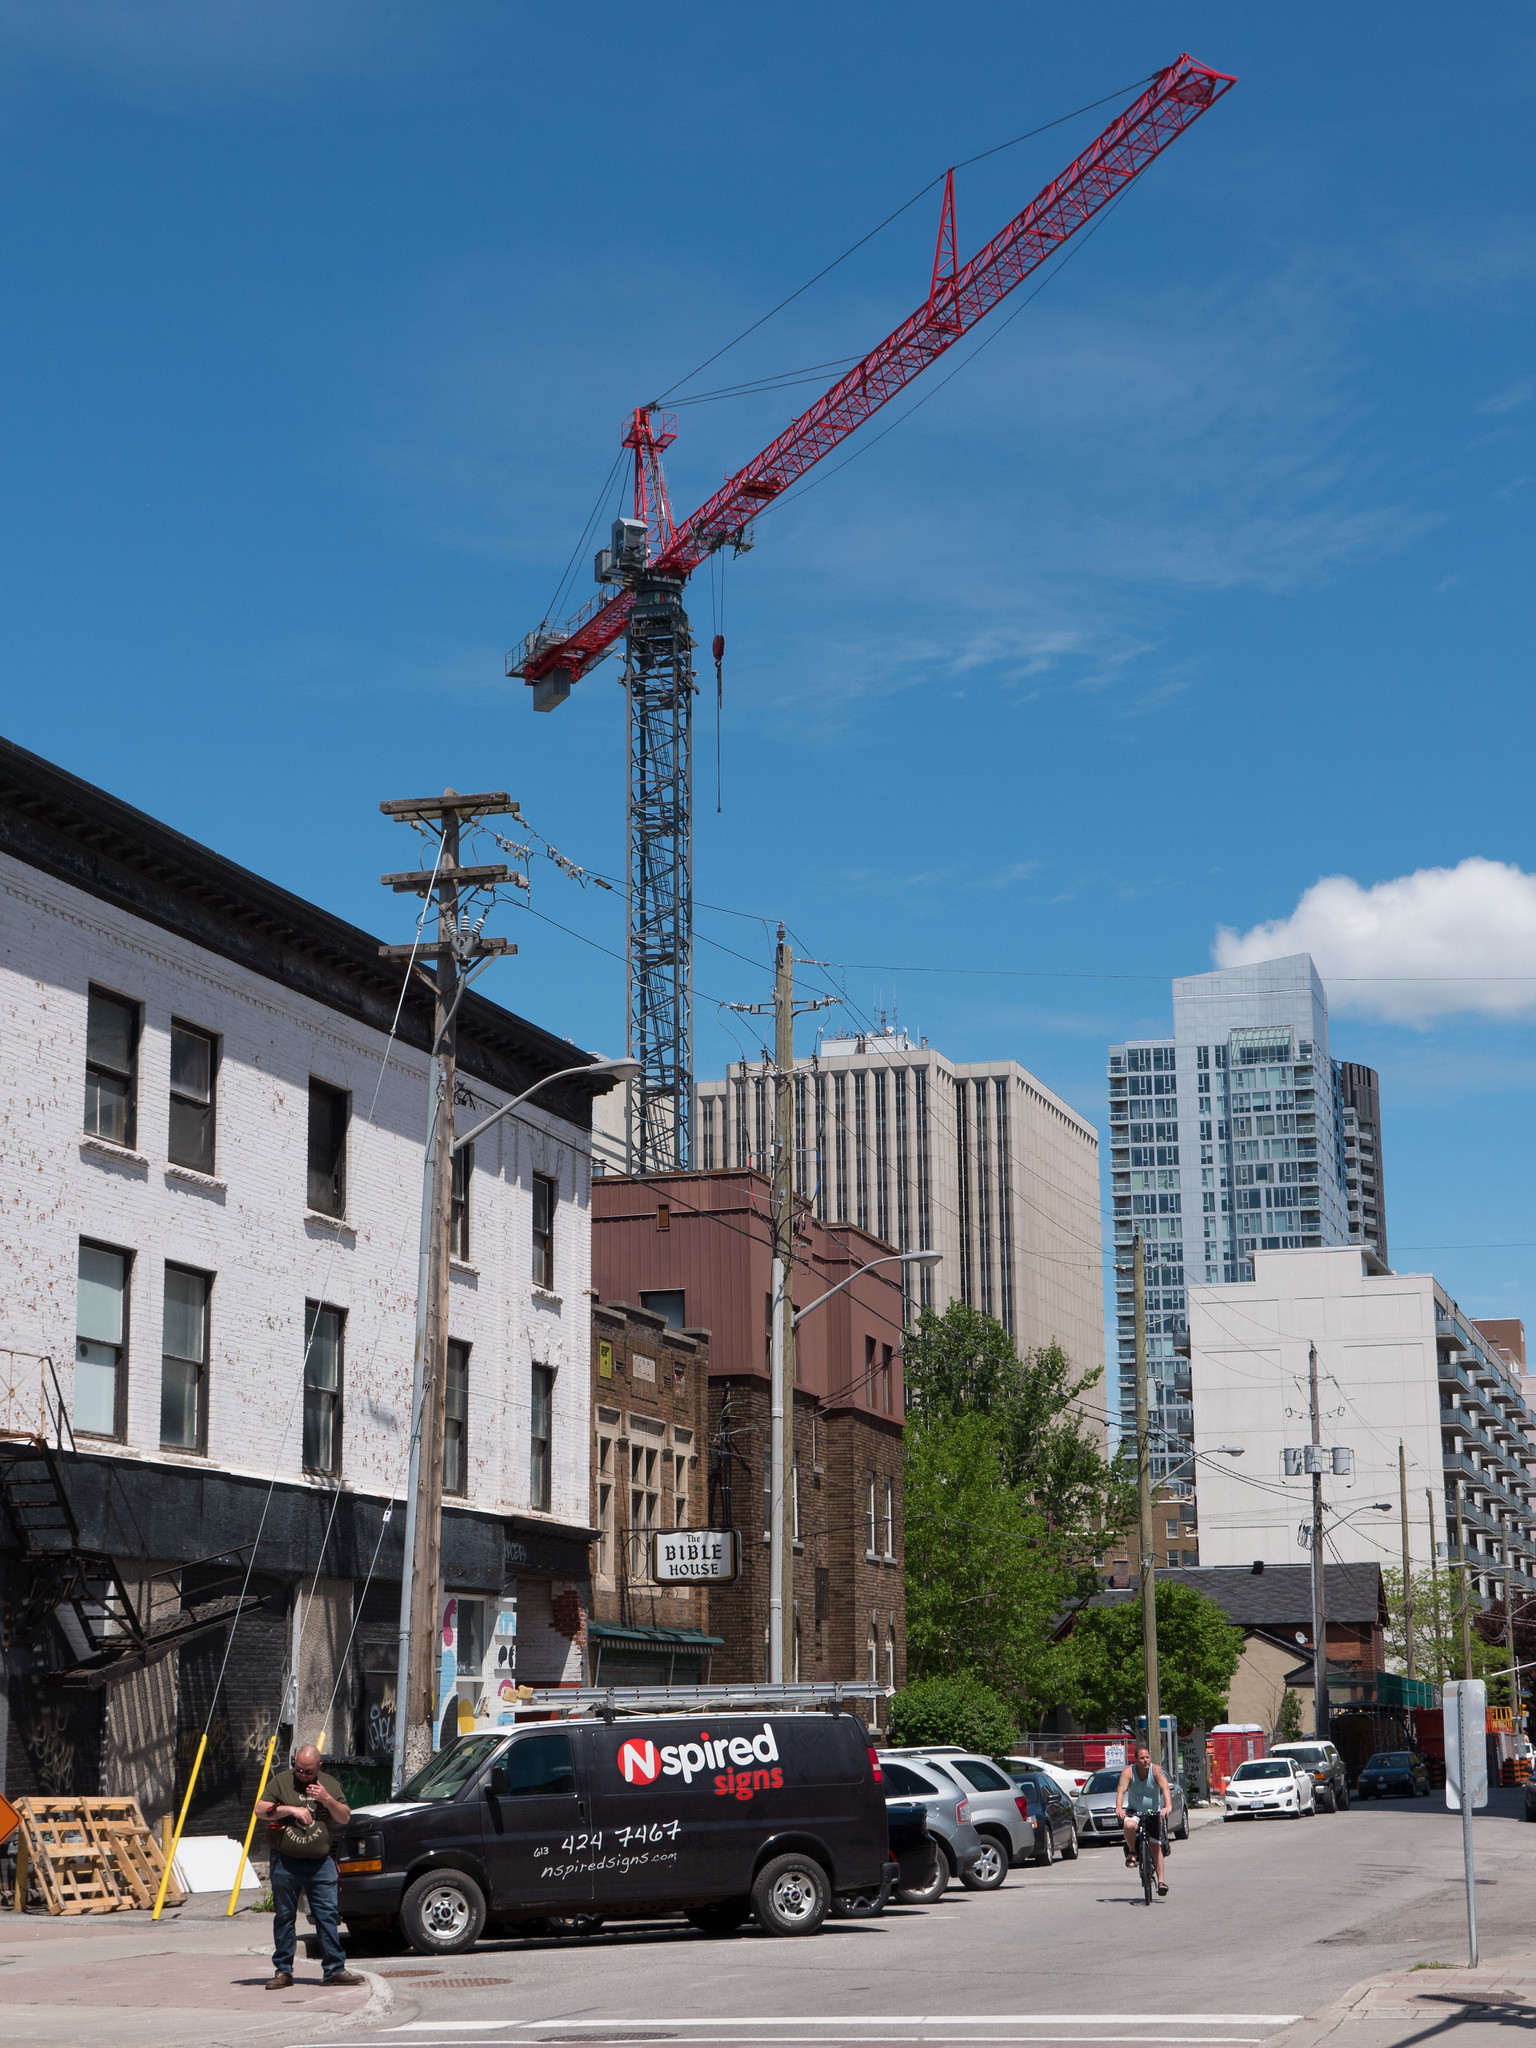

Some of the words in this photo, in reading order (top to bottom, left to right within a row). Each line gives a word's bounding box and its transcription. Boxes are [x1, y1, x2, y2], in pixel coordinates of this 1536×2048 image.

[686, 1534, 700, 1543] The
[665, 1544, 722, 1560] BIBLE
[669, 1563, 719, 1576] HOUSE
[714, 1767, 784, 1801] signs
[533, 1847, 549, 1857] 613
[561, 1831, 603, 1855] 424
[614, 1819, 682, 1847] 7467
[541, 1852, 677, 1880] nspiredsigns.com
